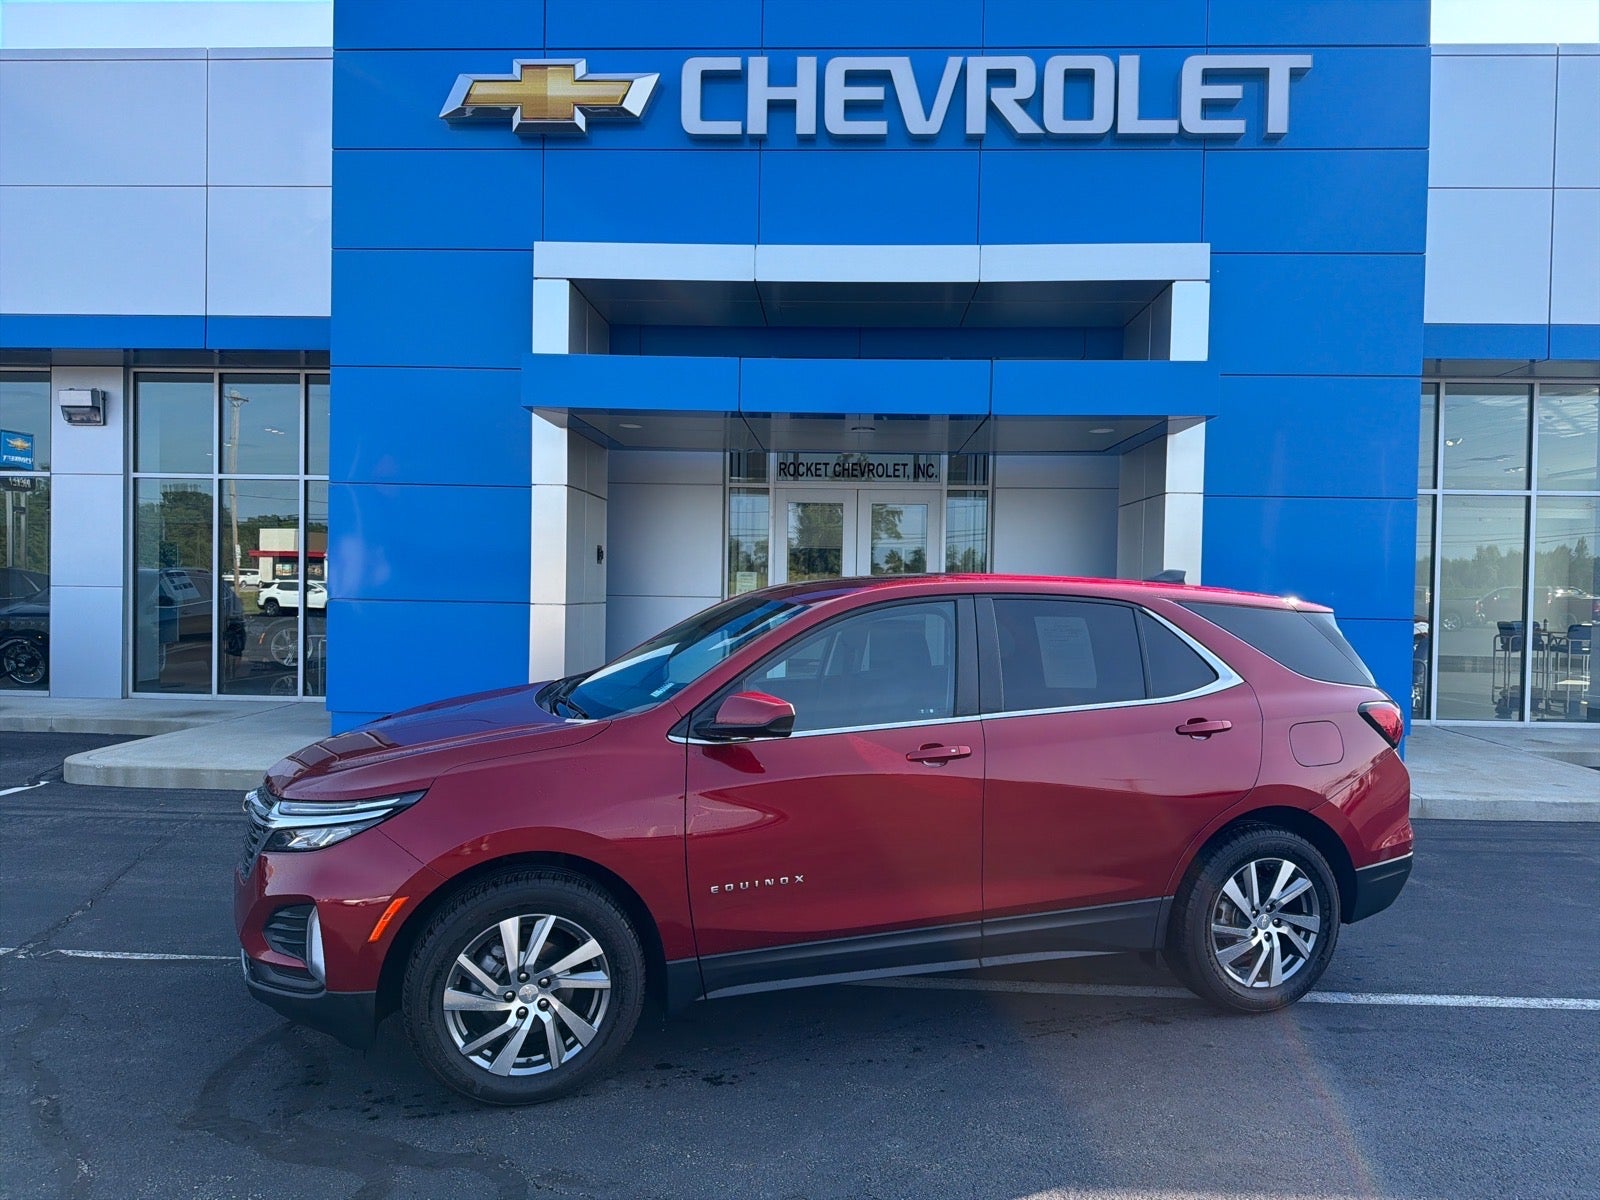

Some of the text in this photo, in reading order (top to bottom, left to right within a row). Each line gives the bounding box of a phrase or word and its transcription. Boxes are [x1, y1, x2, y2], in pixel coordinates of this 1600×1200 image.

[681, 54, 1313, 138] CHEVROLET
[778, 462, 938, 480] ROCKET CHEVROLET, INC.
[710, 874, 804, 894] EQUINOX
